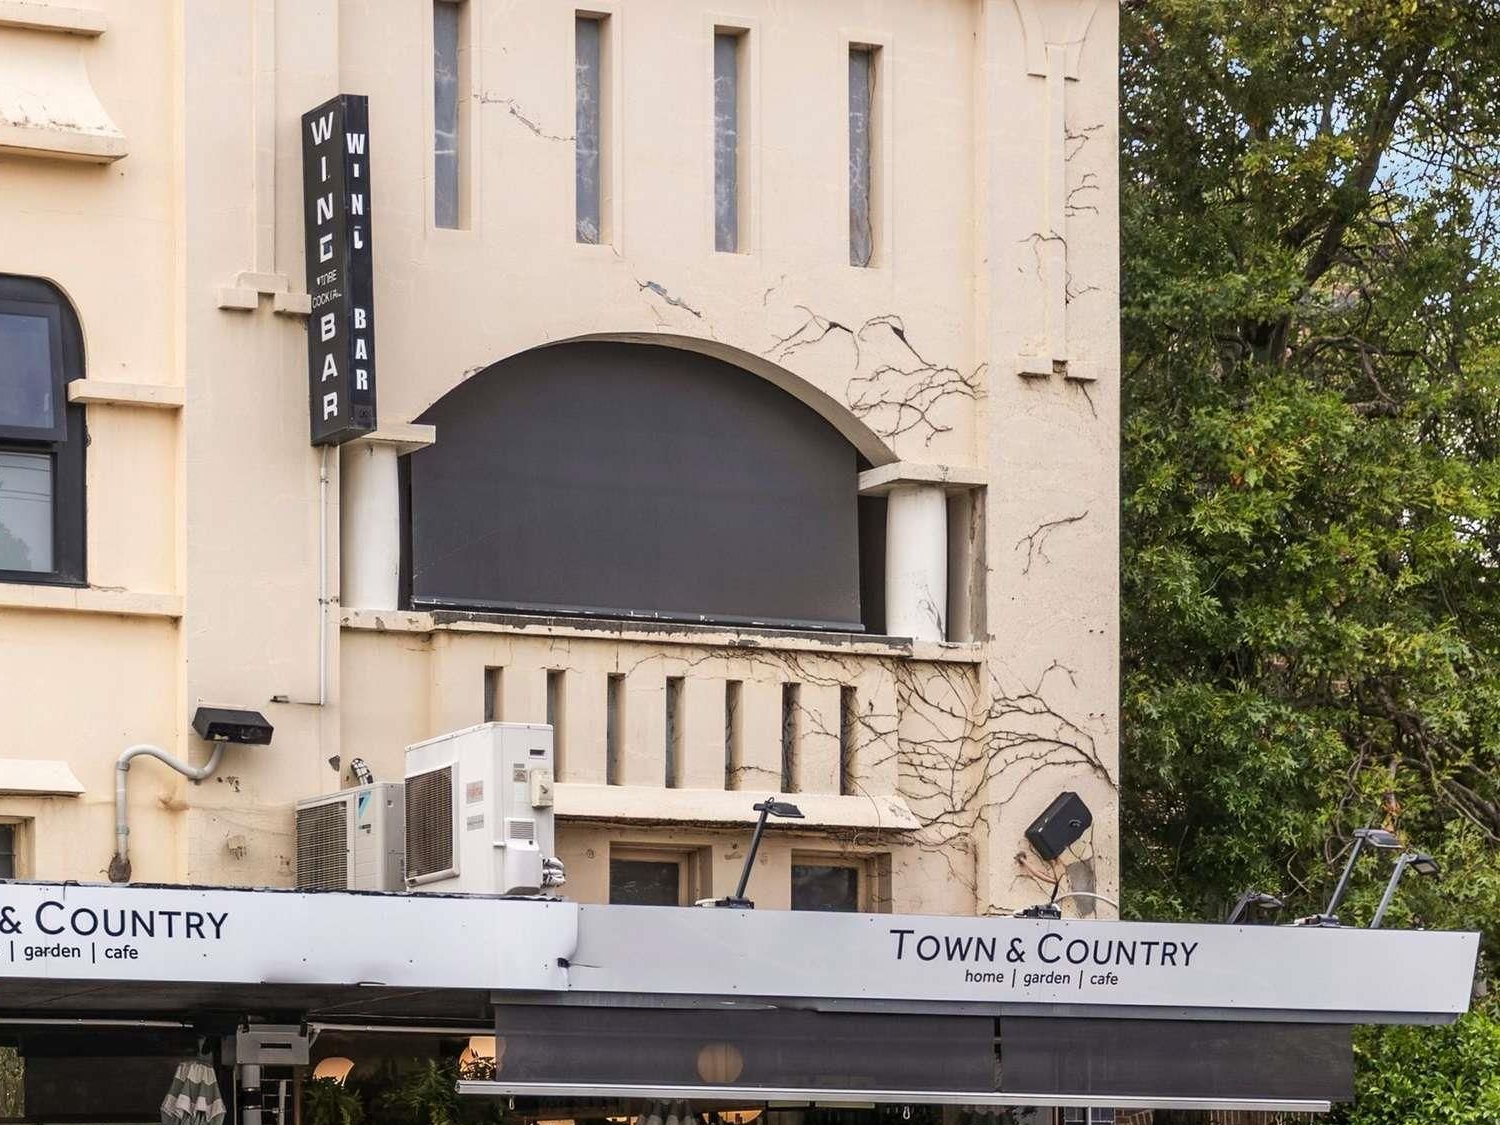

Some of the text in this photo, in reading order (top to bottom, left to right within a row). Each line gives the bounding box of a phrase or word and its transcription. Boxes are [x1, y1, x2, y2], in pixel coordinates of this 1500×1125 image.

[320, 312, 338, 421] BAR
[354, 308, 368, 390] BAR
[35, 901, 229, 939] COUNTRY
[24, 943, 81, 961] garden
[104, 944, 138, 960] cafe
[890, 930, 1198, 967] TOWN & COUNTRY
[965, 970, 1004, 983] home
[1023, 971, 1071, 987] garden
[1090, 973, 1119, 986] cafe
